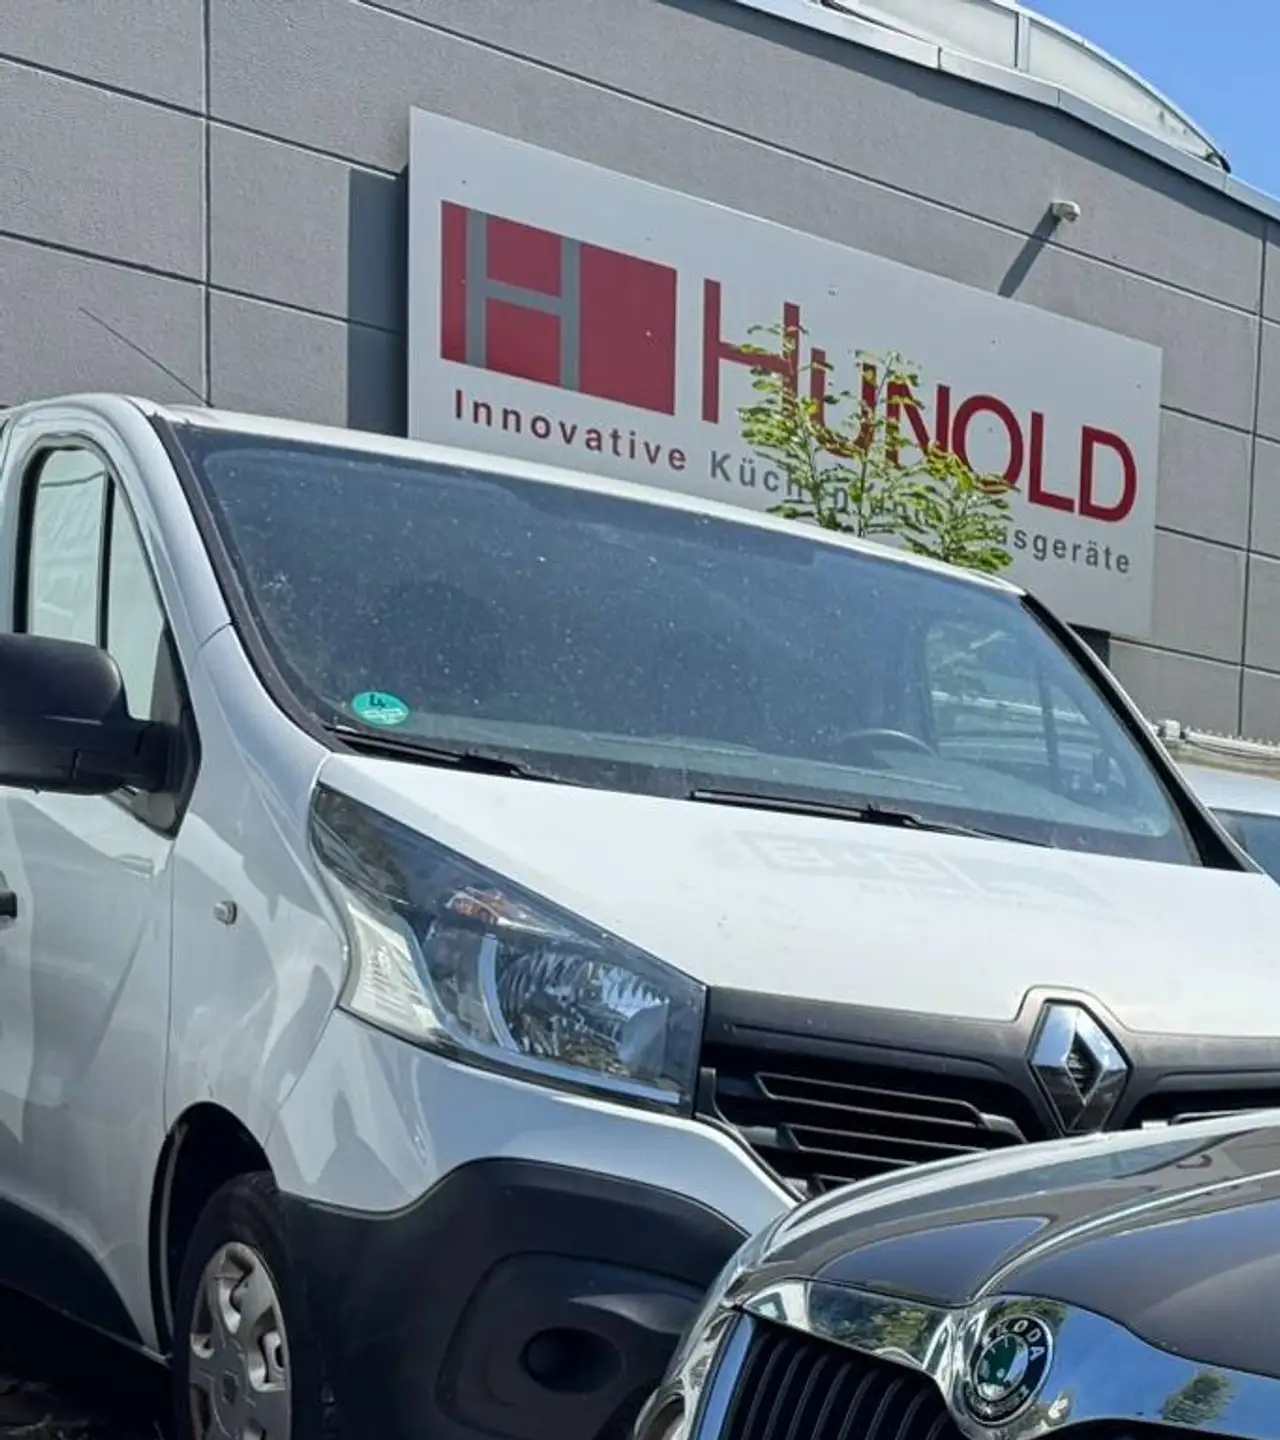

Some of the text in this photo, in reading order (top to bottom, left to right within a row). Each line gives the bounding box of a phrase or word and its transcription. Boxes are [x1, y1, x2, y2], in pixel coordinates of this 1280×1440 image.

[454, 388, 688, 471] Innovative
[711, 450, 849, 514] Küchn
[701, 278, 1138, 523] HUNOLD
